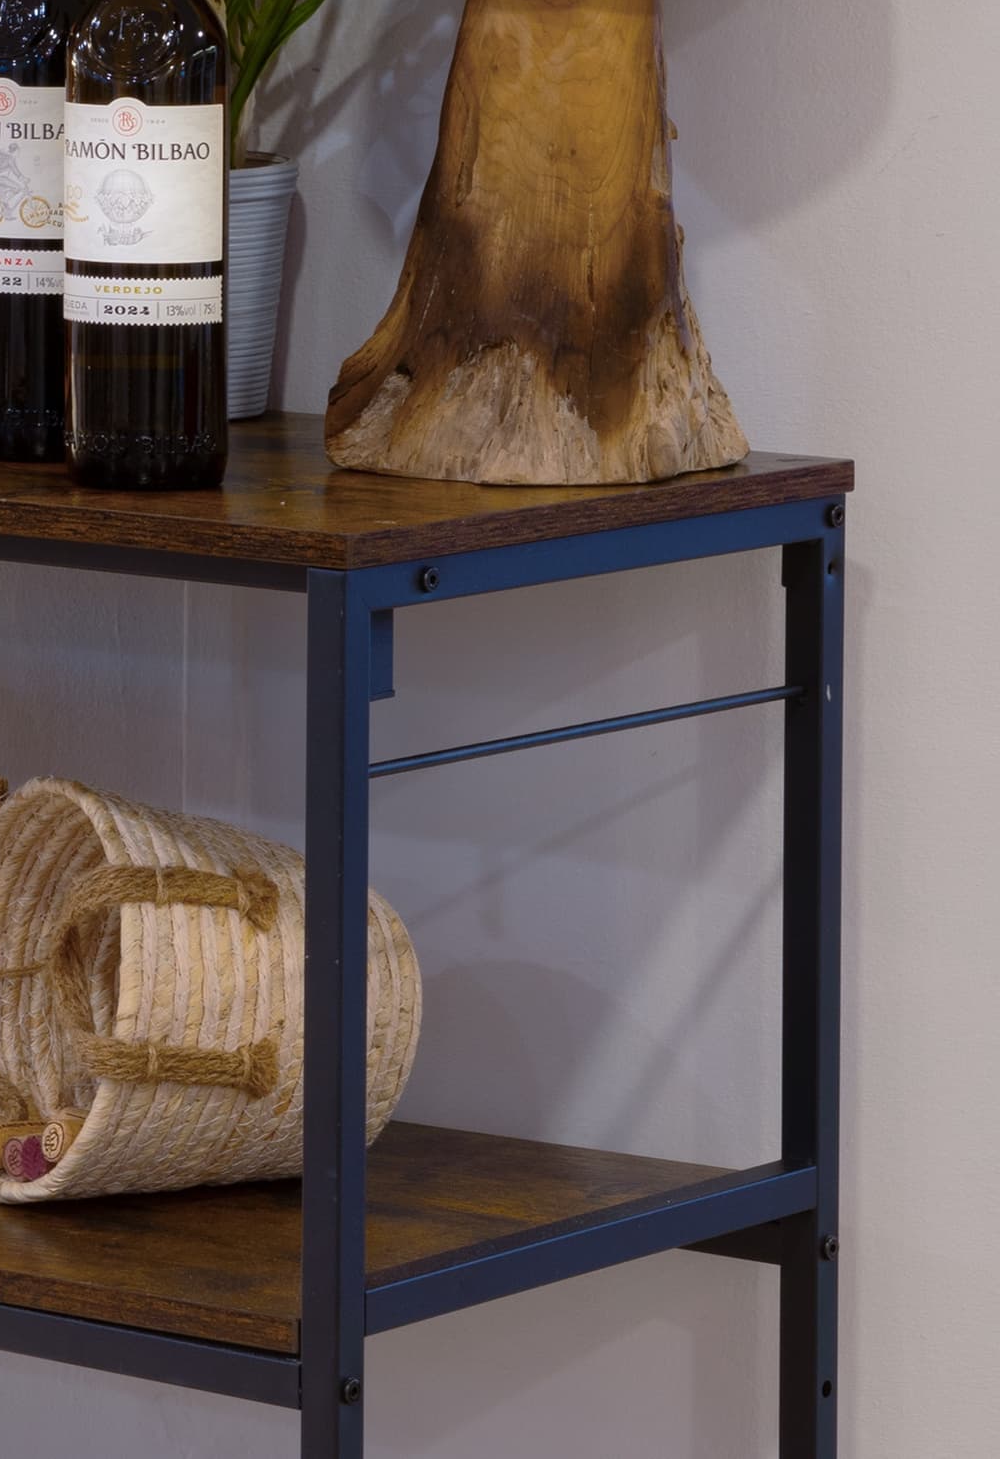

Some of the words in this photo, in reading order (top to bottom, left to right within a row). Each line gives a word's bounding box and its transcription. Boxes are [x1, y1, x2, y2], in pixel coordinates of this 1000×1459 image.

[6, 123, 64, 140] BILBA
[132, 142, 210, 160] BILBAO
[94, 285, 163, 294] VERDEJO
[103, 304, 150, 315] 2024
